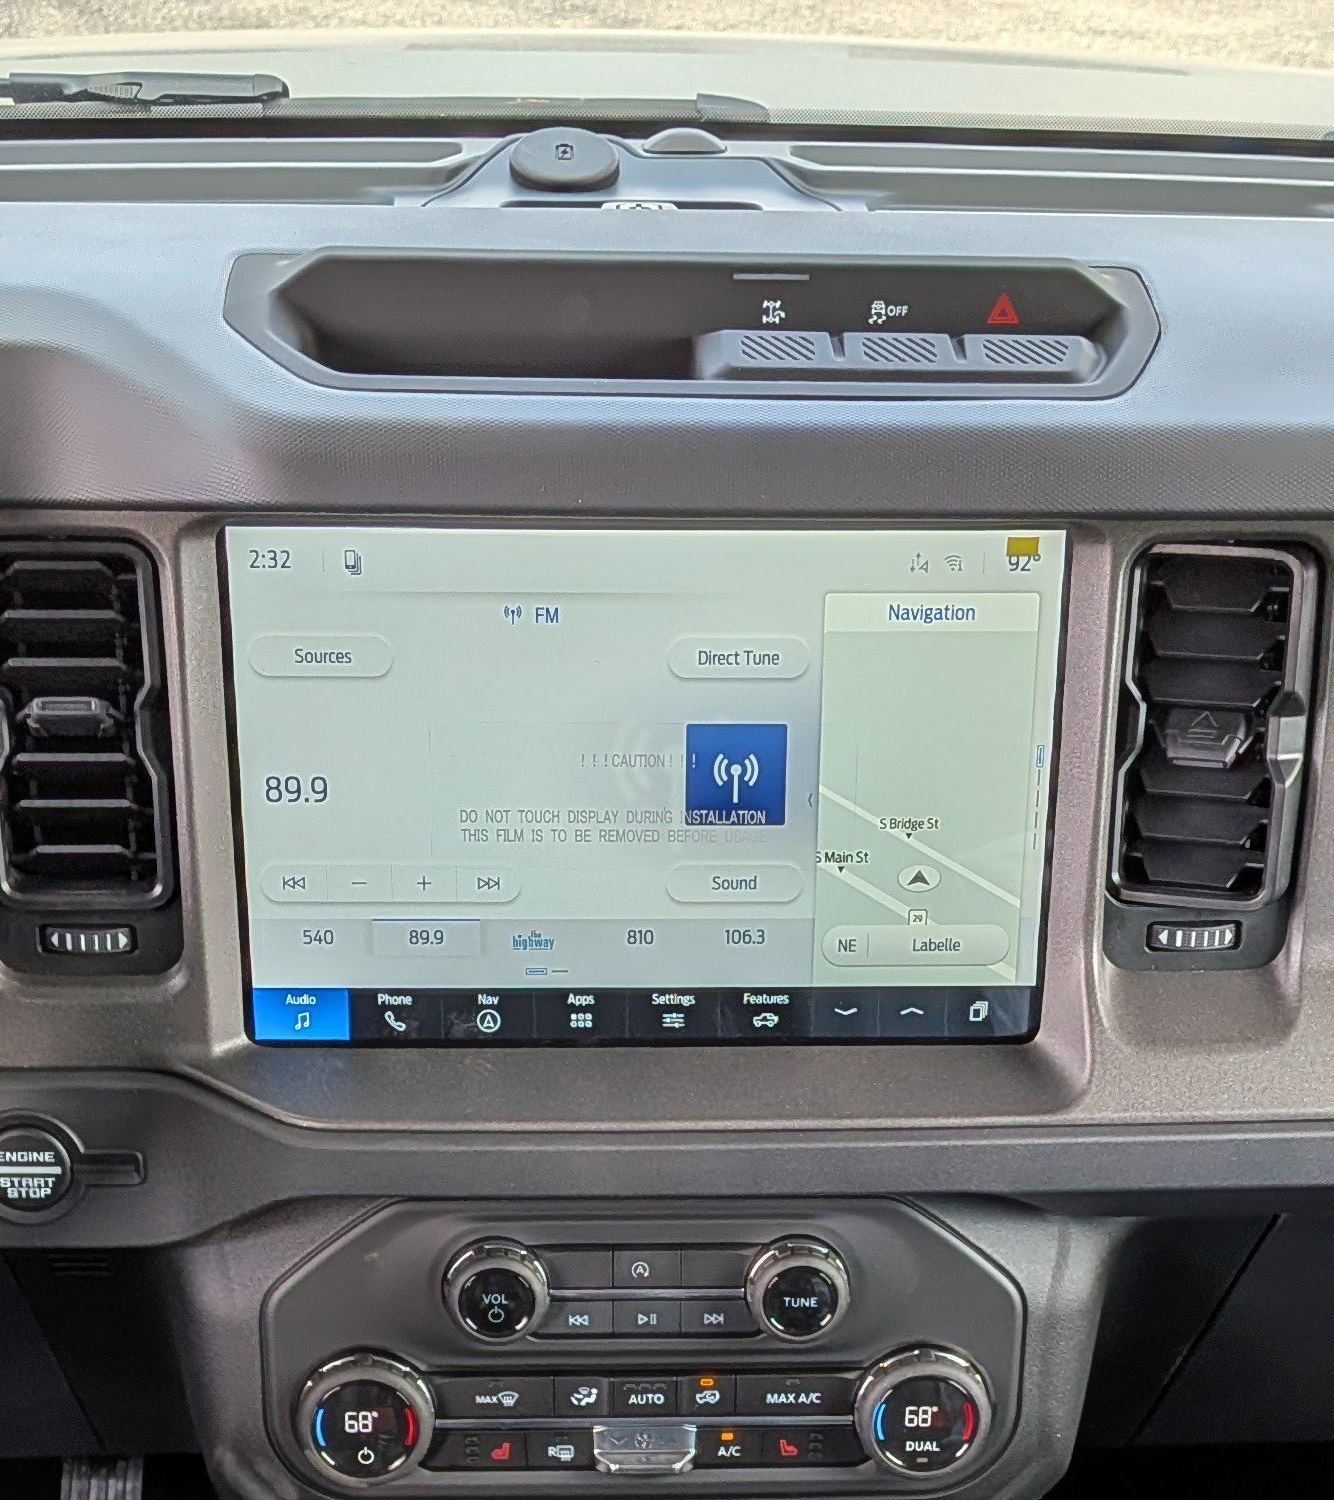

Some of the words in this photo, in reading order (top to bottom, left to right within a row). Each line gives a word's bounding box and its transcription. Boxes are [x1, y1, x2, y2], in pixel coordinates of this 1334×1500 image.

[887, 305, 908, 316] OFF
[250, 550, 291, 569] 2:32
[535, 608, 559, 624] FM
[889, 605, 975, 622] Navigation
[295, 648, 352, 664] Sources
[698, 650, 739, 666] Direct
[743, 650, 779, 666] Tune
[266, 776, 328, 803] 89.9
[460, 811, 477, 823] DO
[485, 811, 510, 823] NOT
[518, 811, 559, 823] TOUCH
[568, 811, 618, 824] DISPLAY
[626, 811, 672, 824] DURING
[681, 811, 766, 824] INSTALLATION
[880, 818, 886, 830] S
[889, 818, 926, 831] Bridge
[928, 818, 938, 830] St
[461, 830, 488, 842] THIS
[496, 830, 524, 842] FILM
[532, 830, 543, 842] IS
[551, 830, 566, 842] TO
[575, 830, 591, 842] BE
[599, 830, 660, 842] REMOVED
[668, 830, 717, 842] BEFORE
[725, 830, 766, 843] USAGE
[825, 852, 852, 864] Main
[855, 852, 869, 864] St
[712, 874, 757, 892] Sound
[913, 914, 922, 923] 29
[303, 930, 334, 945] 540
[409, 930, 444, 945] 89.9
[513, 935, 554, 950] highway
[627, 930, 654, 945] 810
[725, 930, 765, 945] 106.3
[838, 939, 856, 952] NE
[913, 938, 960, 952] Labelle
[286, 995, 316, 1005] Audio
[378, 995, 412, 1005] Phone
[478, 995, 499, 1005] Nav
[568, 995, 595, 1007] Apps
[652, 995, 695, 1008] Settings
[744, 995, 789, 1005] Features
[0, 1177, 55, 1188] START
[7, 1188, 52, 1198] STOP
[482, 1294, 508, 1305] VOL
[784, 1296, 818, 1308] TUNE
[475, 1396, 497, 1404] MAX
[629, 1394, 664, 1404] AUTO
[767, 1393, 796, 1403] MAX
[798, 1393, 821, 1403] A/C
[345, 1411, 378, 1433] 68°
[905, 1406, 939, 1427] 68°
[718, 1446, 741, 1456] A/C
[906, 1442, 939, 1451] DUAL
